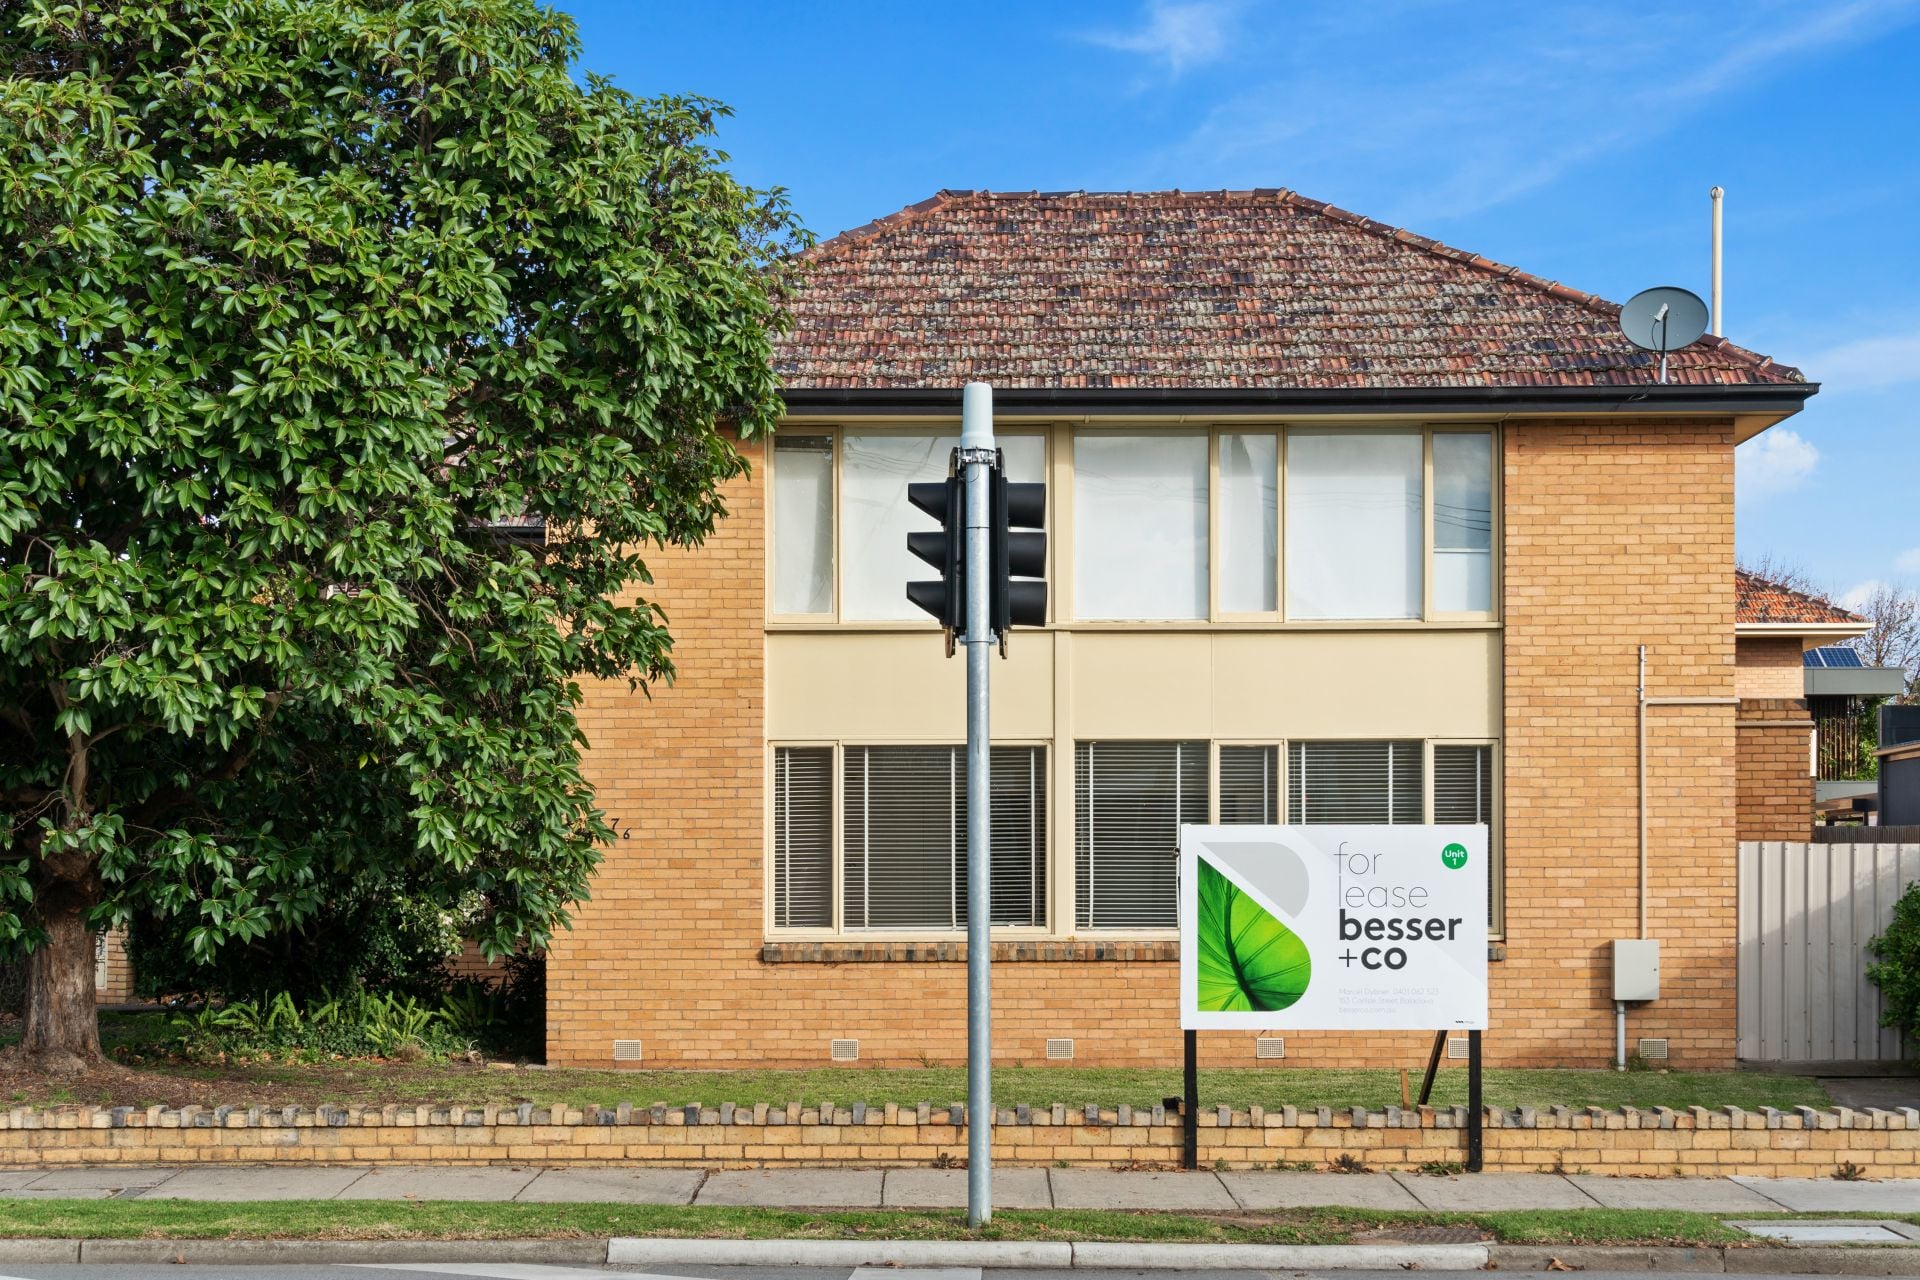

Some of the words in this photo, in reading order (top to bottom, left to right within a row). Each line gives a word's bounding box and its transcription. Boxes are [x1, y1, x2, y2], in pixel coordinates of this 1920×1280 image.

[1333, 841, 1382, 875] for
[1444, 850, 1465, 858] Unit
[1451, 858, 1457, 866] 1
[1338, 875, 1429, 908] lease
[1339, 908, 1463, 941] besser
[1338, 947, 1408, 970] +co
